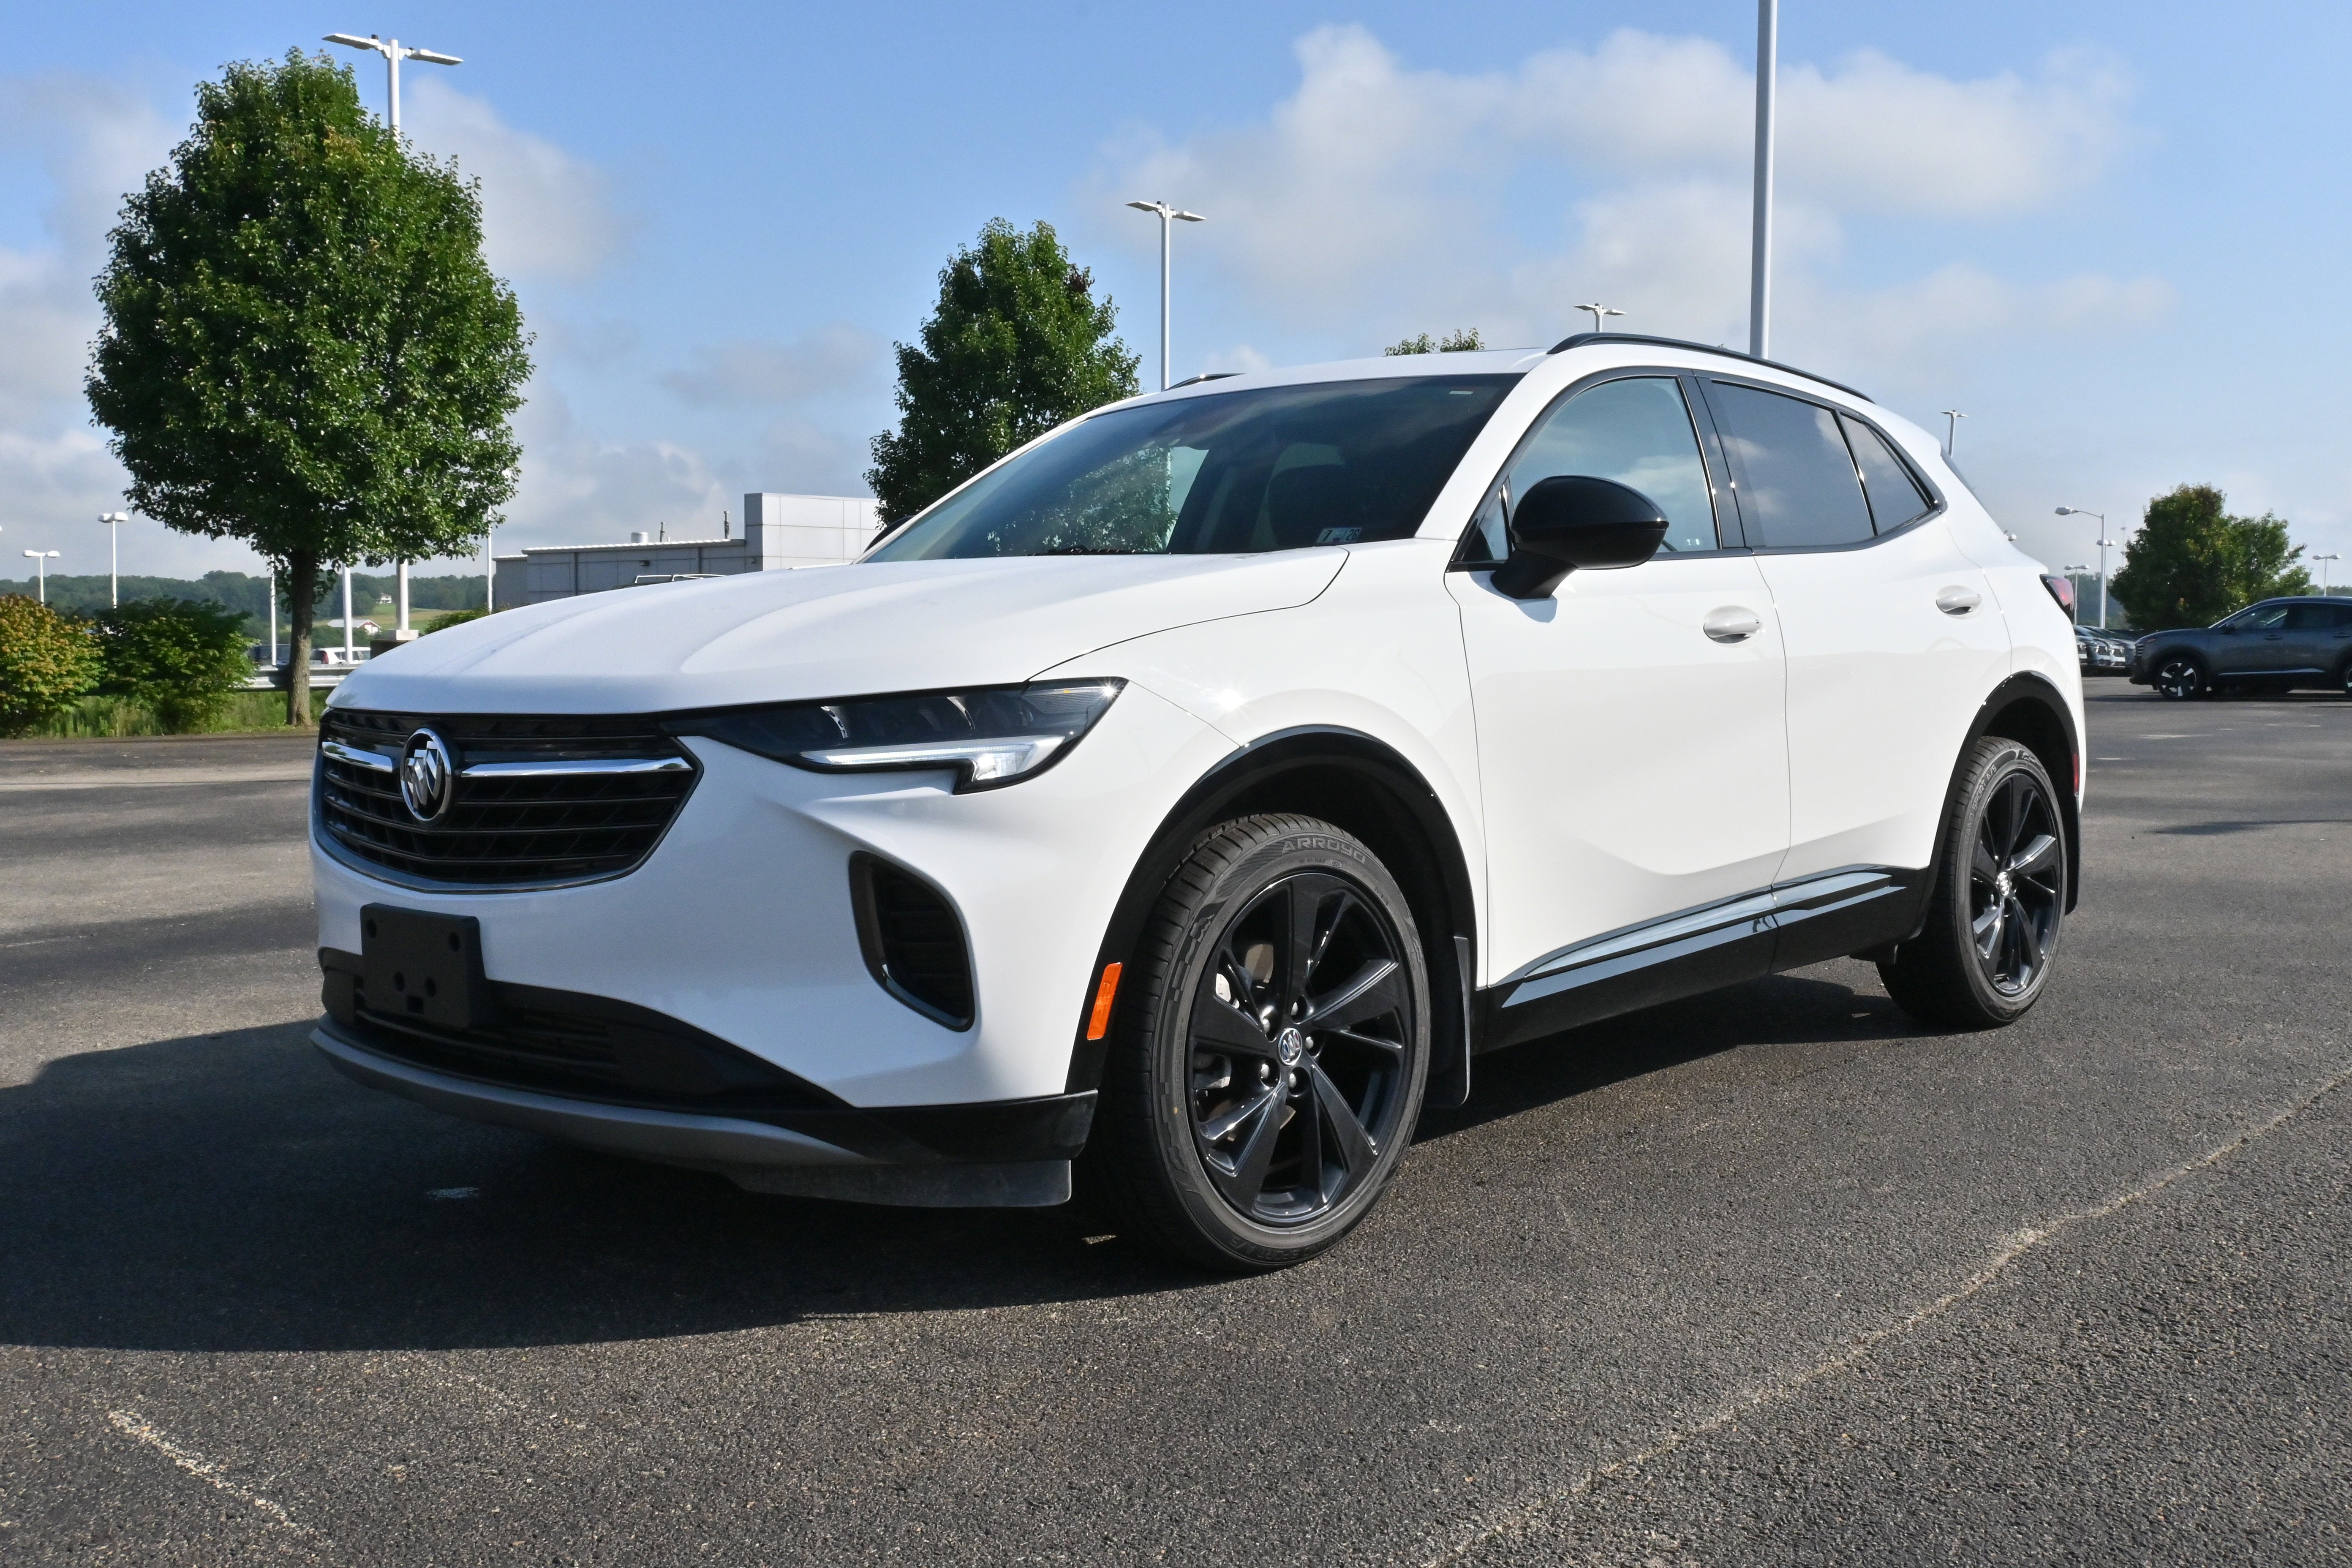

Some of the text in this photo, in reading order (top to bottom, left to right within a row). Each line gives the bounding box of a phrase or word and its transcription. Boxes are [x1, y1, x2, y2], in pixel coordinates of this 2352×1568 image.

[1322, 529, 1360, 542] 7 26
[1972, 781, 1986, 810] SPORT
[1986, 764, 1997, 781] A/S
[1282, 838, 1366, 864] ARROYO
